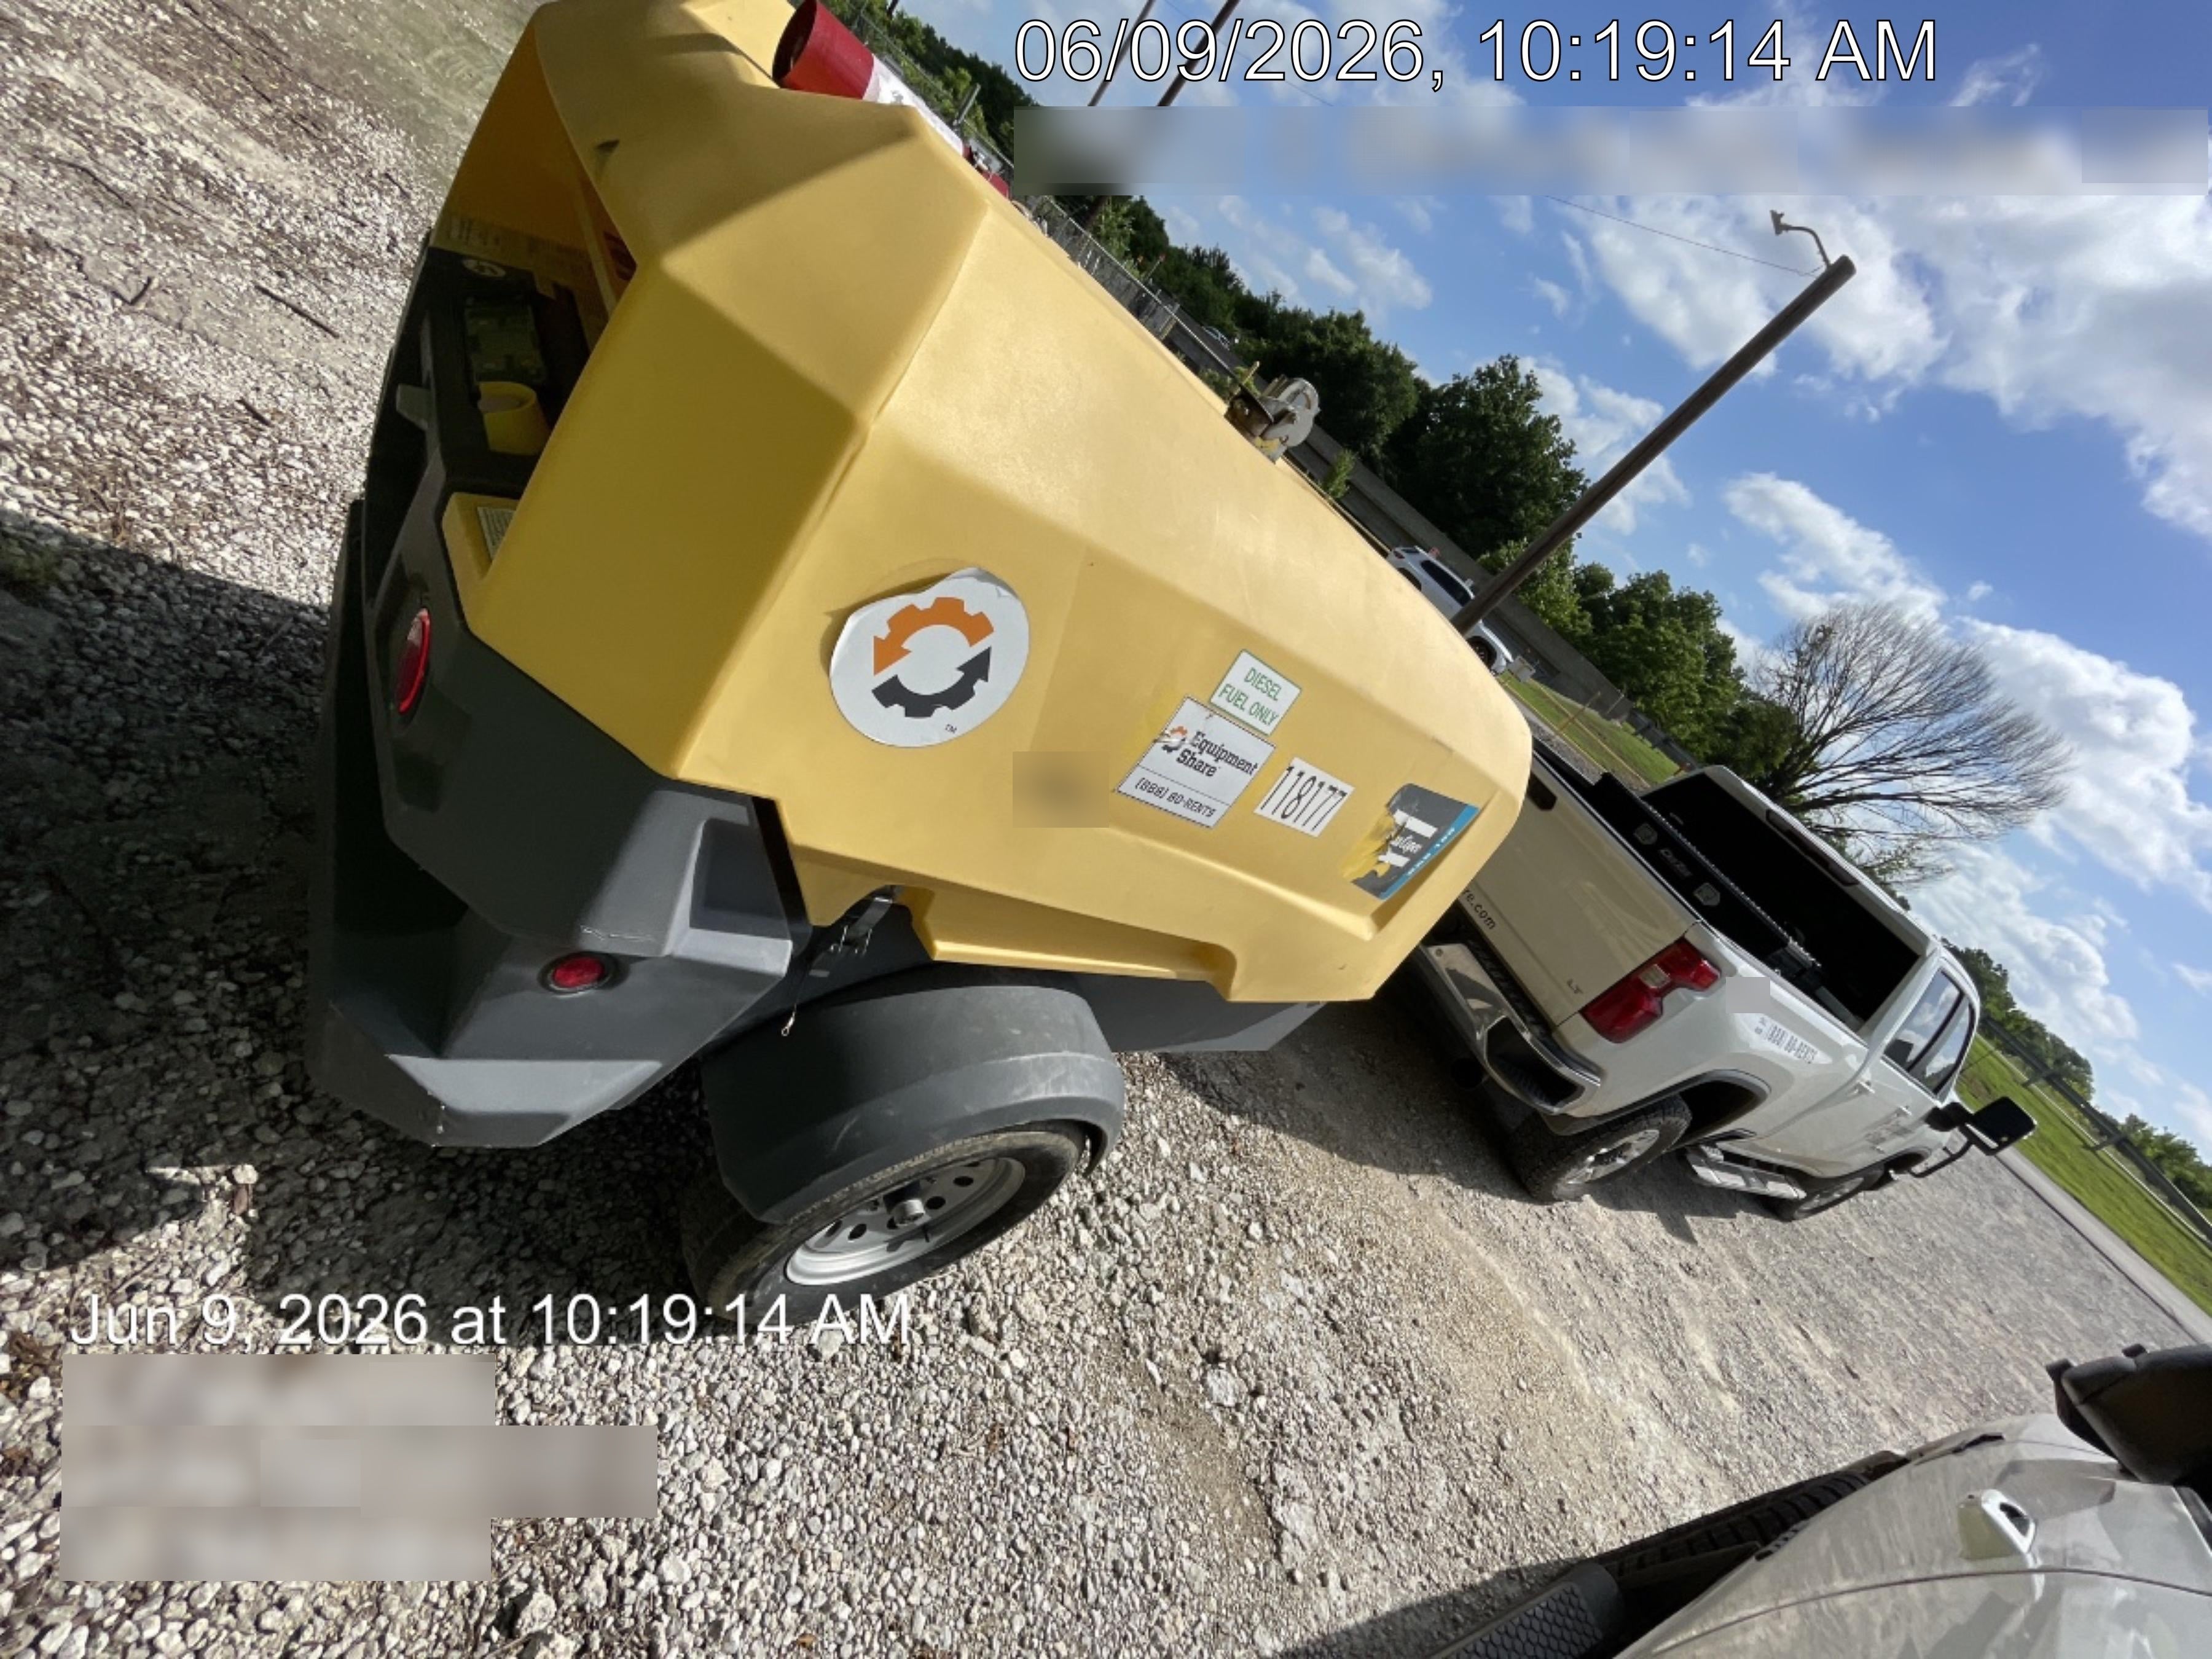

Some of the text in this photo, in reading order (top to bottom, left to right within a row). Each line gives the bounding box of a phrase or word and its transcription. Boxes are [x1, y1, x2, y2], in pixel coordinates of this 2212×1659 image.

[1244, 667, 1281, 701] DIESEL
[1218, 683, 1279, 725] FUEL ONLY
[1176, 748, 1217, 777] Share
[1190, 731, 1258, 775] Equipment
[1135, 777, 1169, 799] (888)
[1260, 766, 1348, 831] 118177
